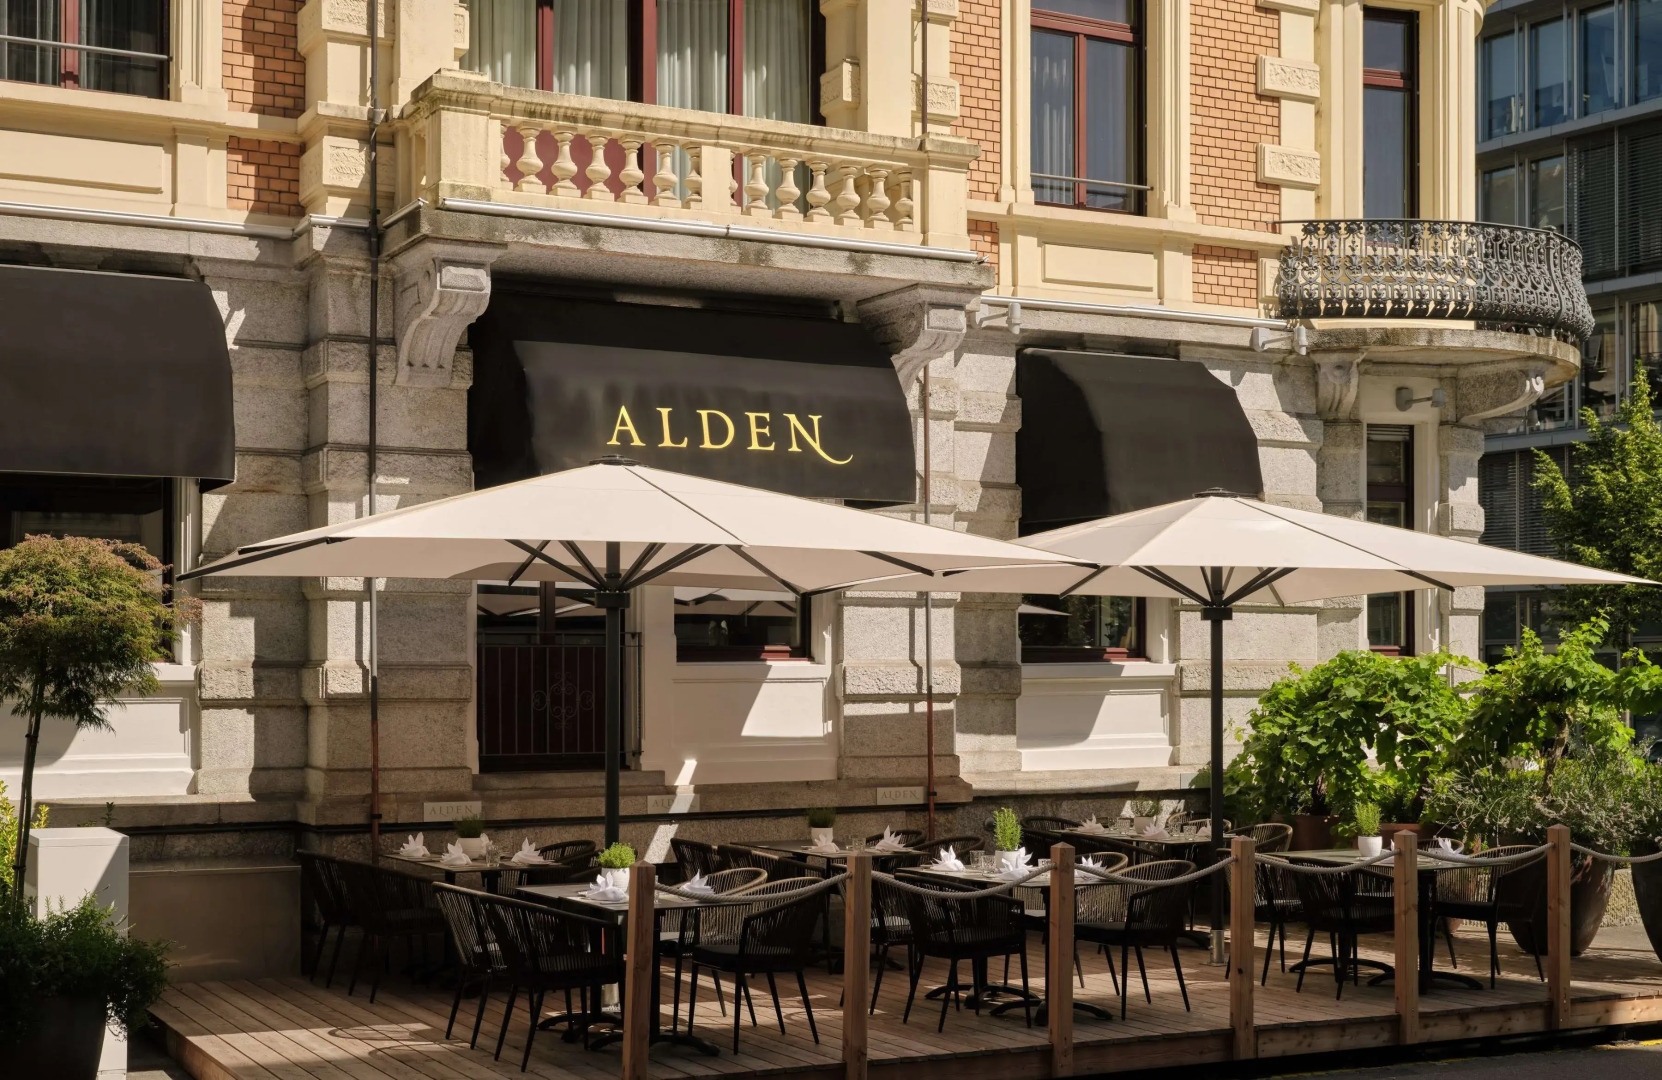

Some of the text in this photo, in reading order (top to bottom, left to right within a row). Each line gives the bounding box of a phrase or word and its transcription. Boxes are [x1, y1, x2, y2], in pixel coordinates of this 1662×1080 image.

[606, 404, 854, 465] ALDEN
[881, 789, 920, 801] ALDEN
[429, 805, 476, 817] ALDEN
